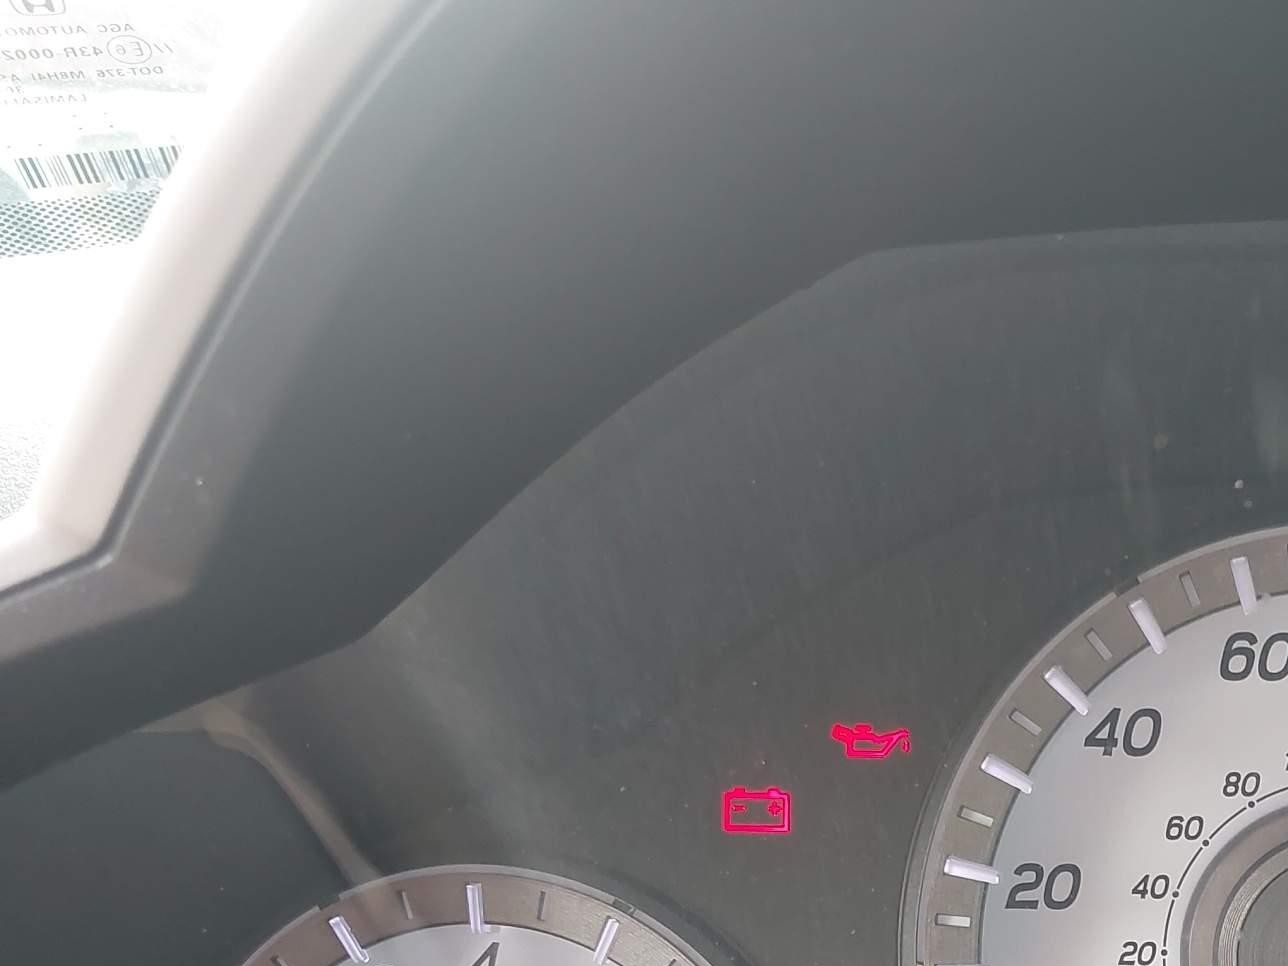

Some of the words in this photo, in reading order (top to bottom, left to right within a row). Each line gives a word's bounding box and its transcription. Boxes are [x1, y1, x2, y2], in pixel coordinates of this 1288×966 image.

[1084, 708, 1161, 757] 40
[1223, 772, 1260, 797] 80
[1166, 816, 1203, 840] 60
[1005, 863, 1081, 910] 20
[1132, 875, 1169, 899] 40
[1118, 942, 1156, 965] 20
